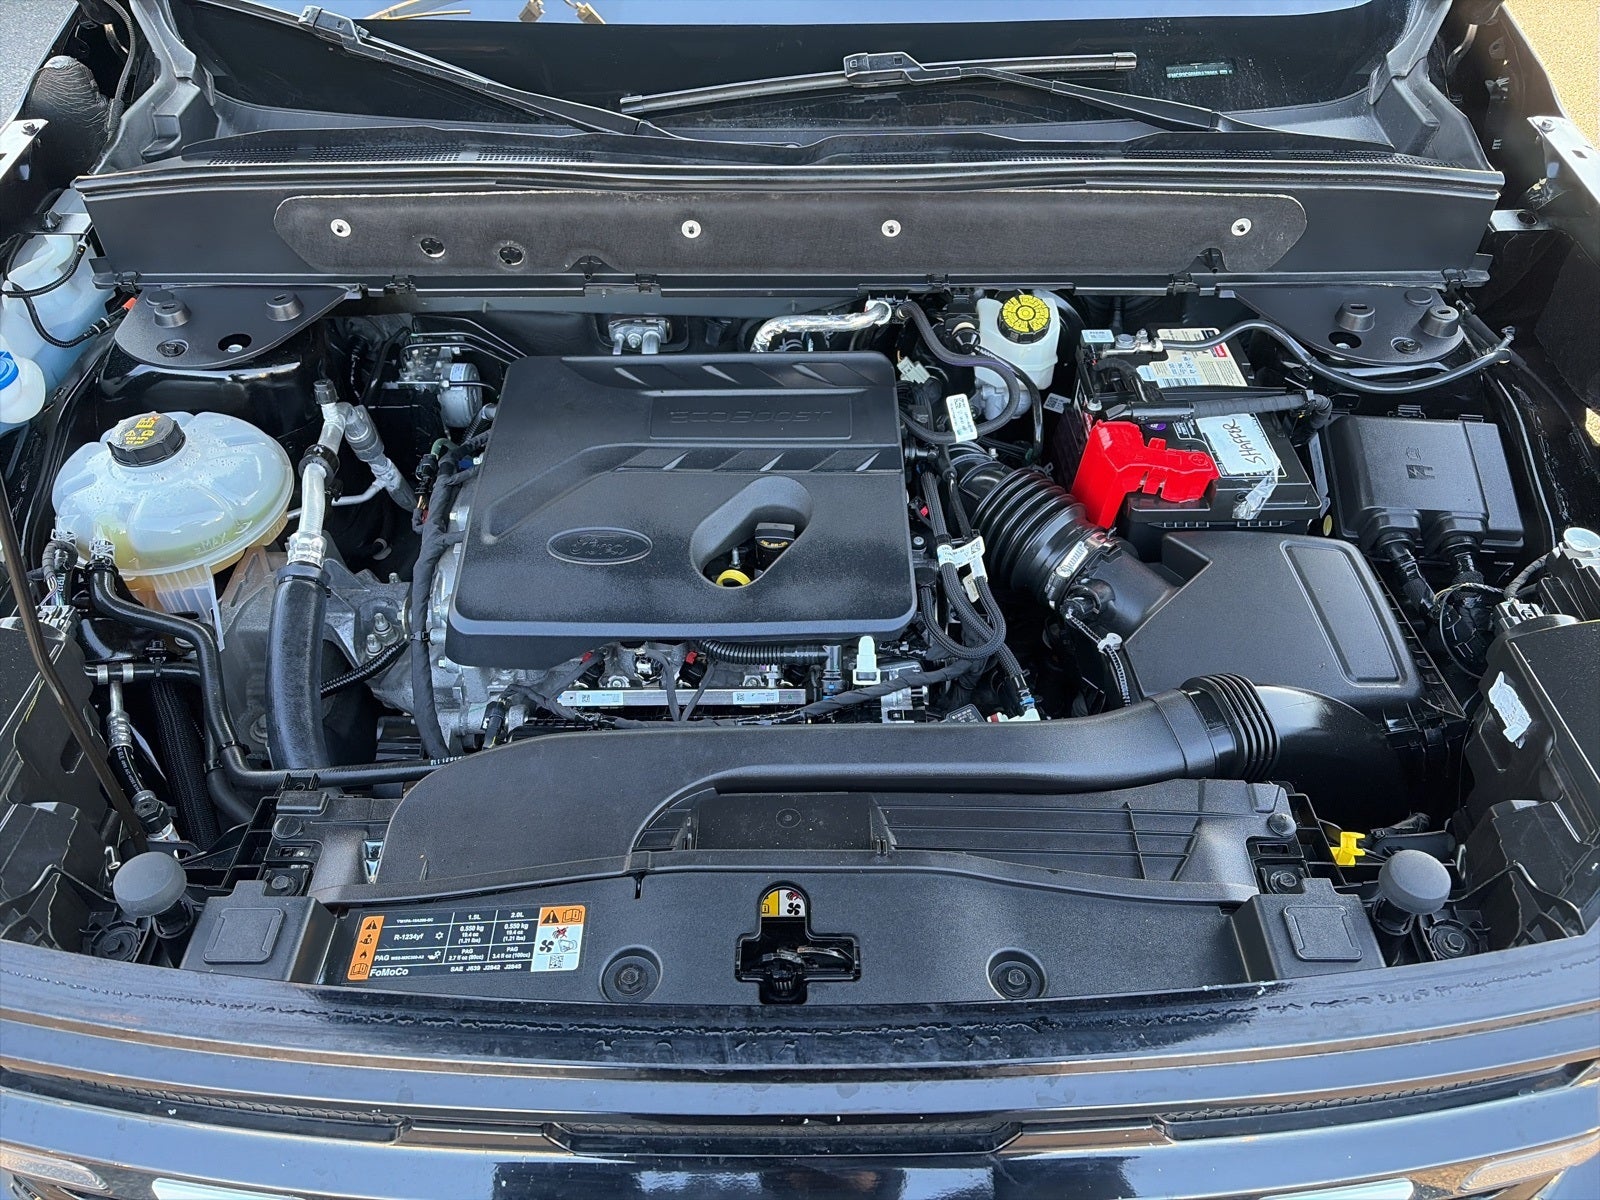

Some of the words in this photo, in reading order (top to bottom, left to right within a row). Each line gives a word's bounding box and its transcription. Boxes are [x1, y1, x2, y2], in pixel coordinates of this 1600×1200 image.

[670, 410, 833, 425] ECOBOOST
[393, 932, 424, 941] R-1234yf
[374, 954, 390, 962] PAG
[369, 967, 409, 977] FoMoCo
